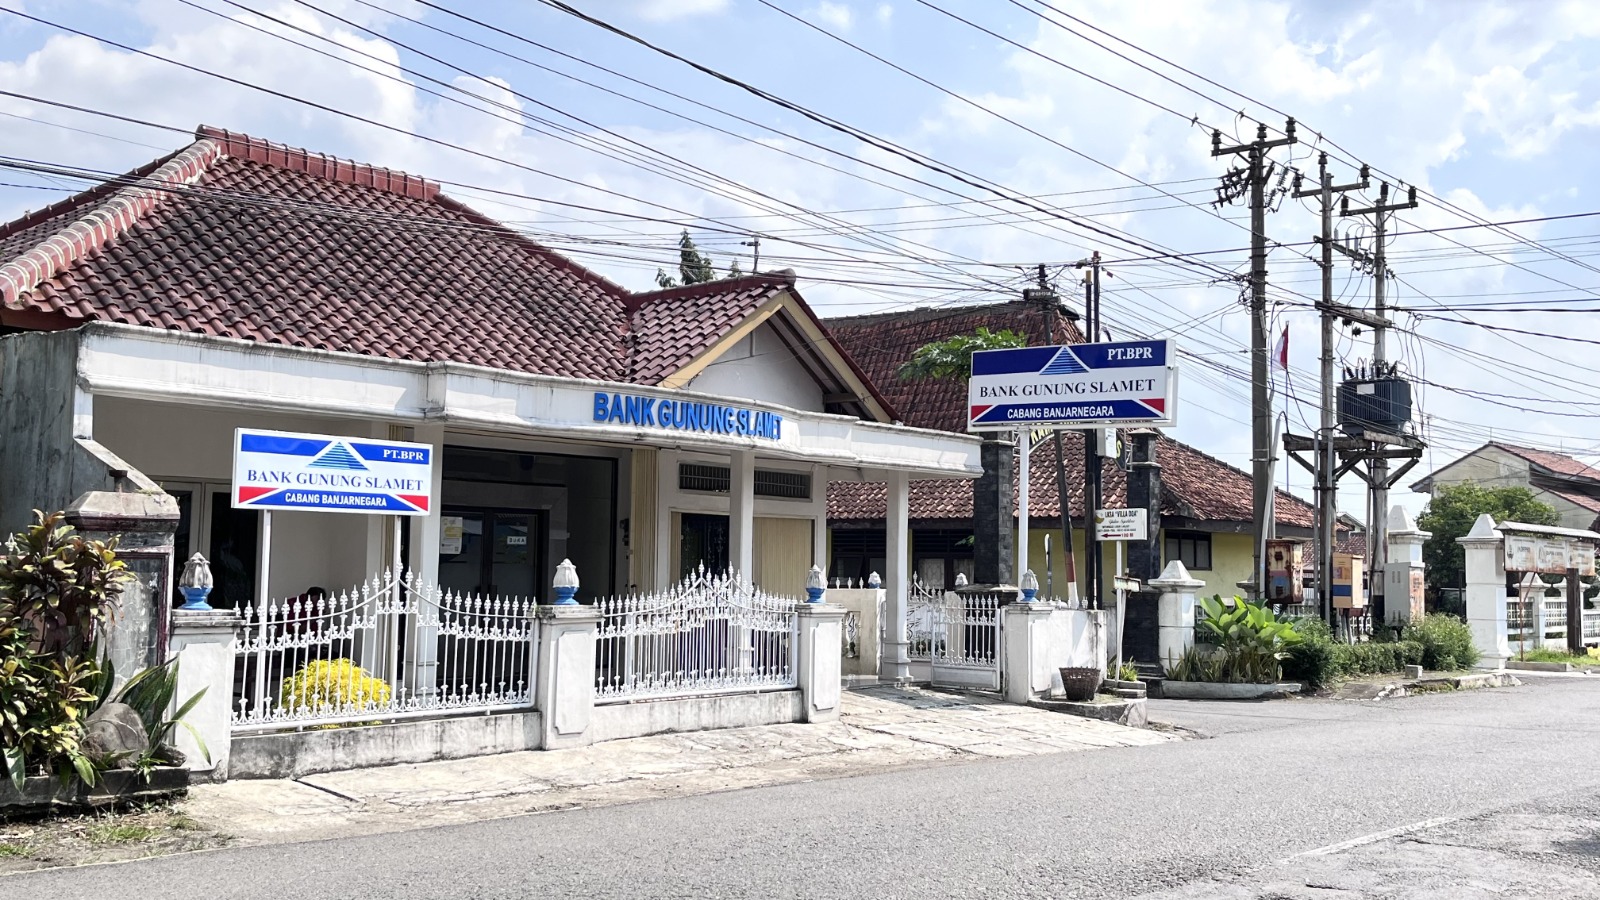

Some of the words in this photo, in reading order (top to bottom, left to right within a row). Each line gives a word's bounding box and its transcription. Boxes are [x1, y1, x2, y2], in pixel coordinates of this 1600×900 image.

[1107, 347, 1152, 361] PT.BPR
[980, 385, 1019, 398] BANK
[1022, 381, 1086, 397] GUNUNG
[1089, 378, 1156, 394] SLAMET
[593, 392, 656, 425] BANK
[658, 399, 735, 434] GUNUNG
[736, 408, 783, 440] SLAMET
[1007, 407, 1042, 419] CABANG
[1043, 405, 1115, 418] BANJARNEGARA
[383, 449, 424, 461] PT.BPR
[247, 469, 292, 484] BANK
[296, 472, 361, 488] GUNUNG
[365, 476, 424, 491] SLAMET
[285, 492, 320, 504] CABANG
[322, 494, 387, 507] BANJARNEGARA
